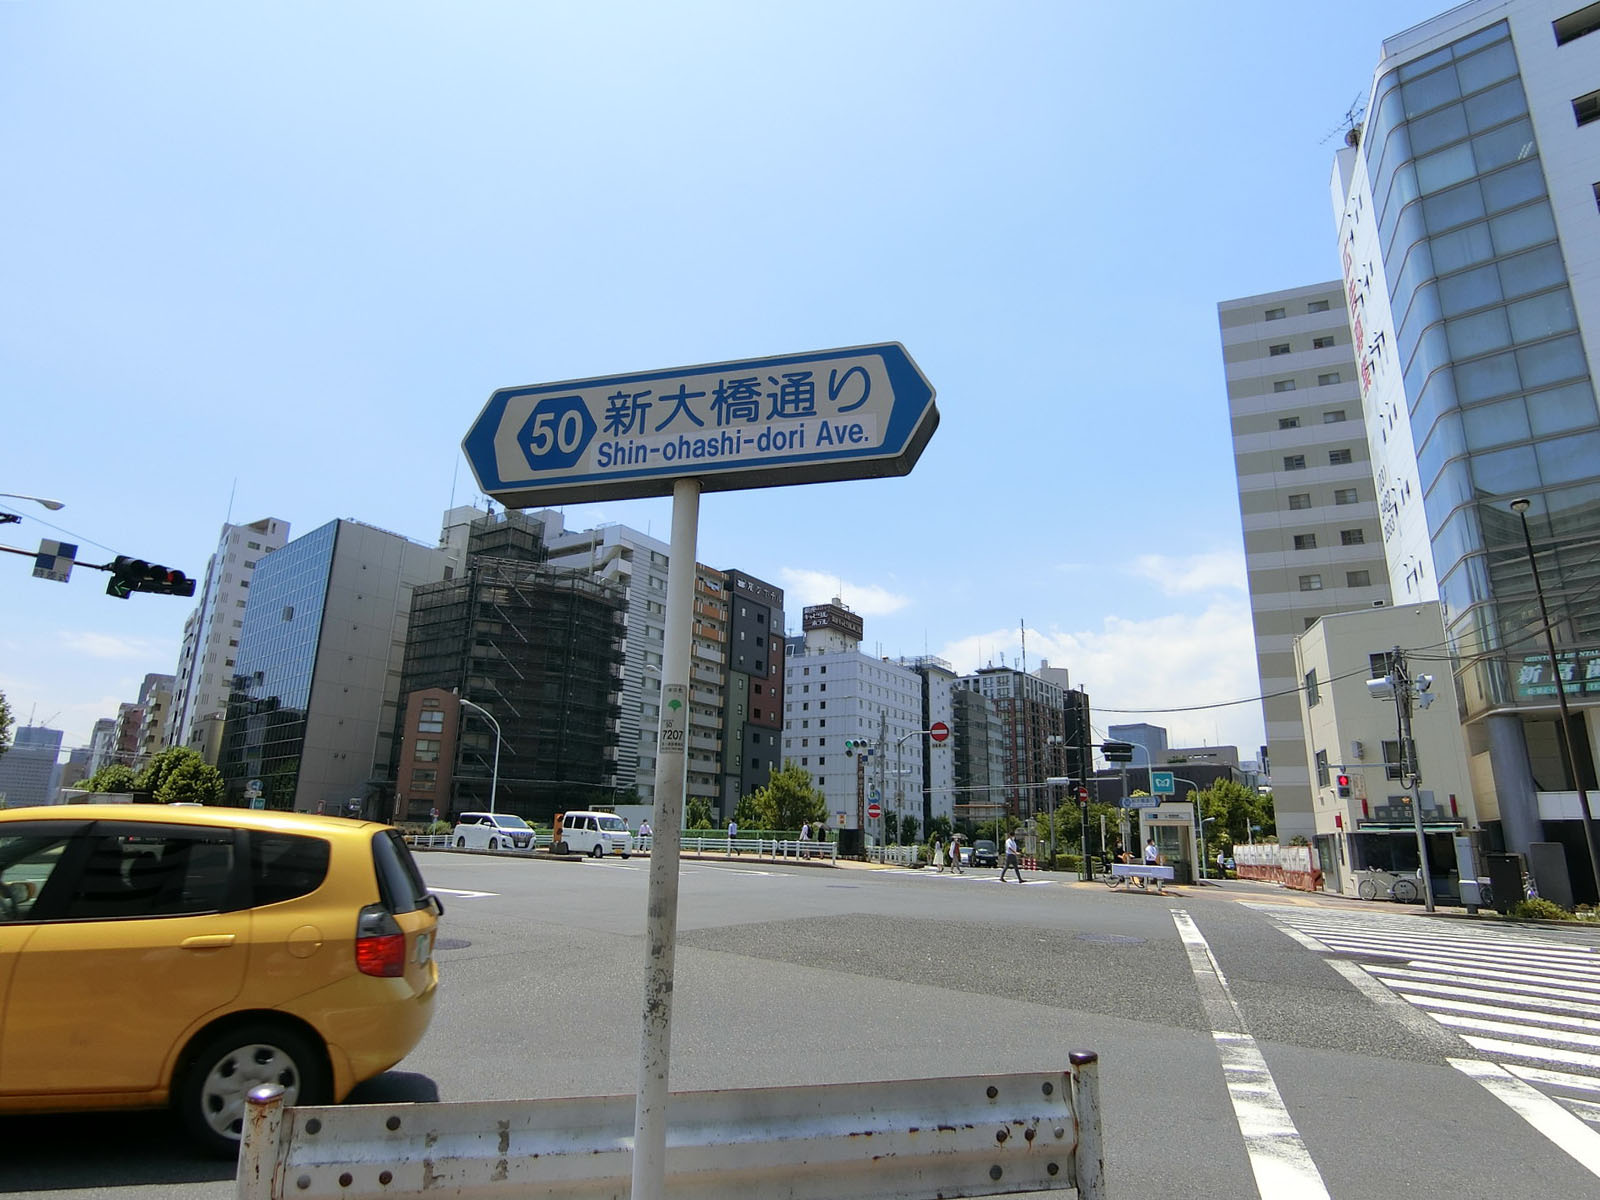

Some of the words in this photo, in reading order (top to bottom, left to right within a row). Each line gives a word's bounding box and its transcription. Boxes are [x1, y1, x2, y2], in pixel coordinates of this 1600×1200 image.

[602, 365, 871, 438] 新大橋通り
[530, 408, 586, 456] 50
[597, 422, 805, 468] Shin-ohashi-dori
[816, 420, 870, 446] Ave.
[662, 730, 683, 740] 7207
